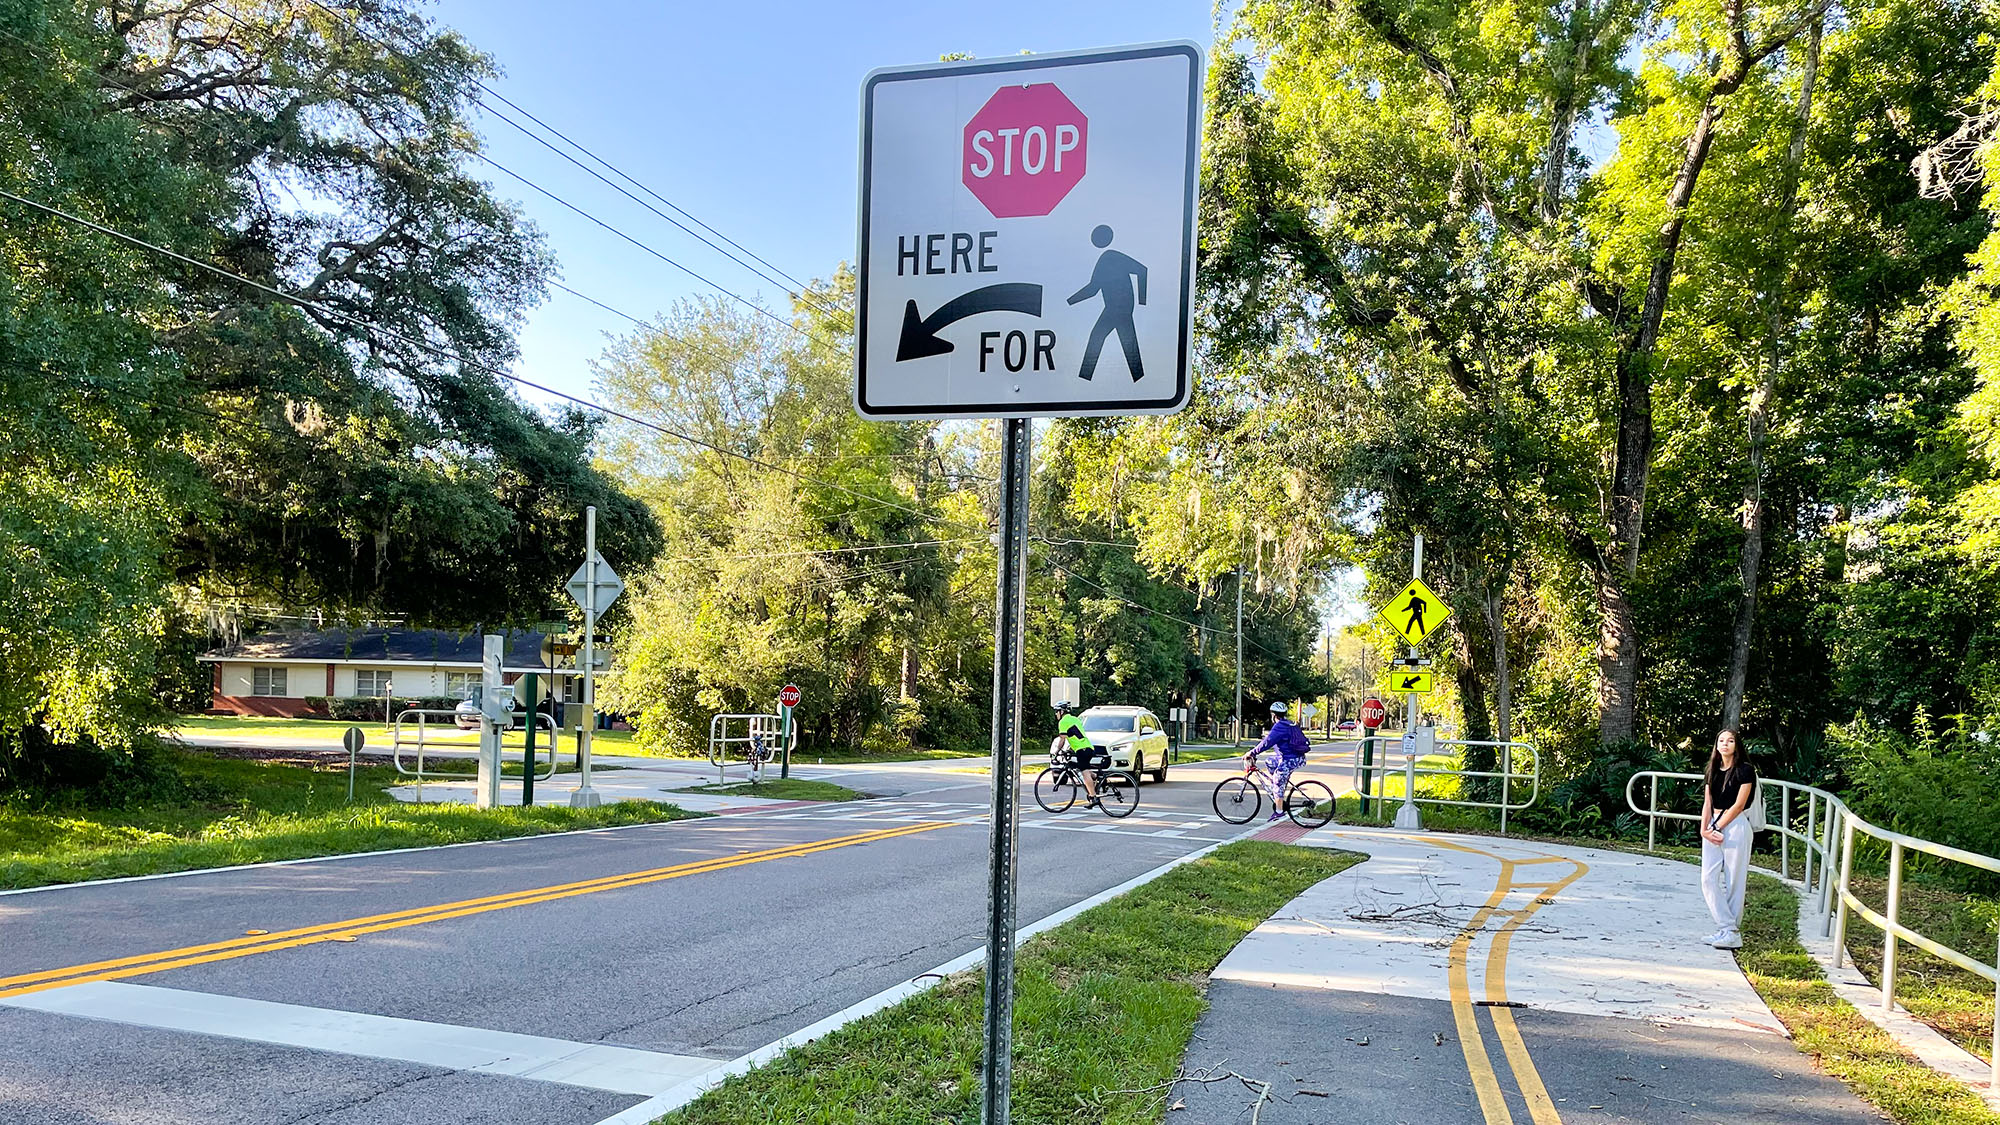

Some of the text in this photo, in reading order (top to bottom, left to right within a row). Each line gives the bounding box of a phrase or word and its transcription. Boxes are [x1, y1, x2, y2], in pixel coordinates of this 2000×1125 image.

[969, 124, 1080, 178] STOP
[897, 230, 999, 277] HERE
[979, 329, 1057, 373] FOR
[781, 691, 799, 701] STOP
[1362, 707, 1384, 720] STOP
